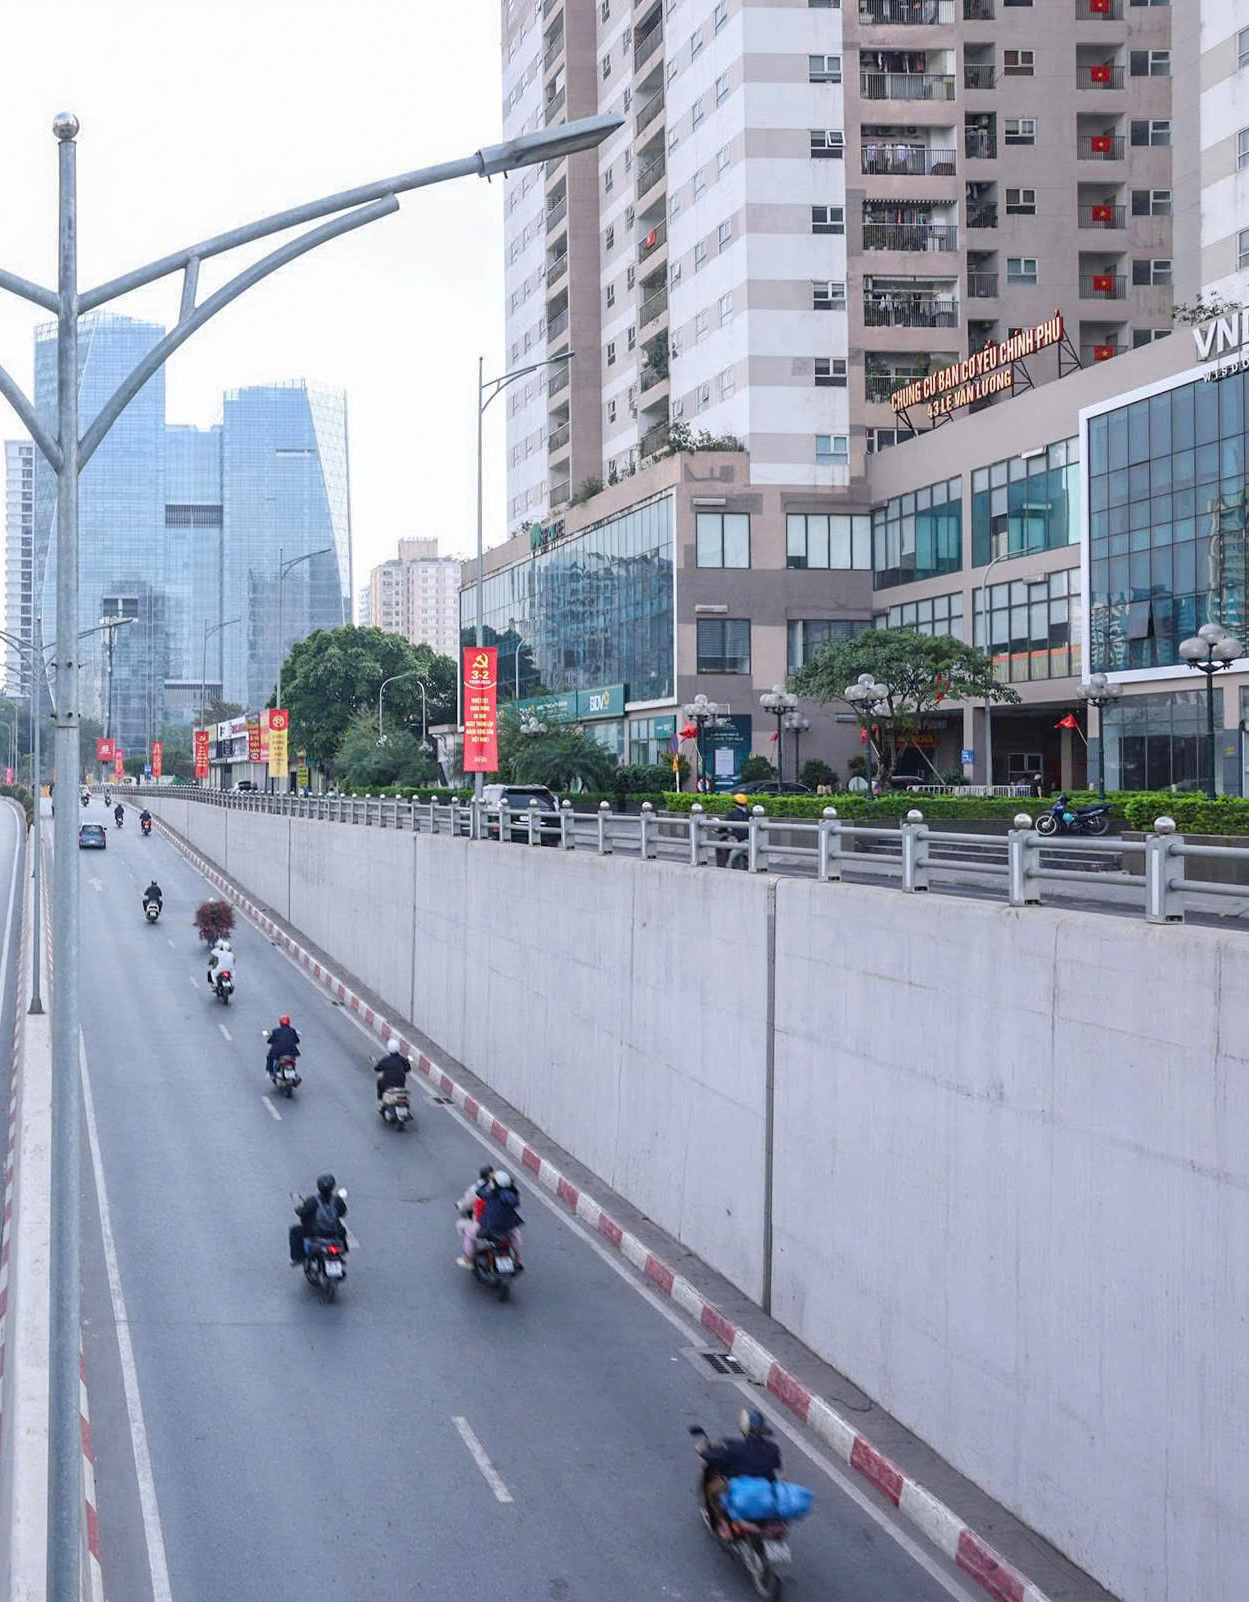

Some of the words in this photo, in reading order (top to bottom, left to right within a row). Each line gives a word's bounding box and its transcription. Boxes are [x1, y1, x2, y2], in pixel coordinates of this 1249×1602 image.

[891, 385, 922, 412] CHUNG
[923, 371, 938, 397] CƯ
[938, 364, 960, 392] BAN
[962, 354, 977, 381] CƠ
[976, 340, 998, 374] YẾU
[999, 329, 1034, 363] CHÍNH
[1036, 309, 1063, 349] PHỦ
[976, 369, 1013, 398] LƯƠNG
[471, 670, 490, 680] 3-2
[590, 695, 604, 711] BIDV
